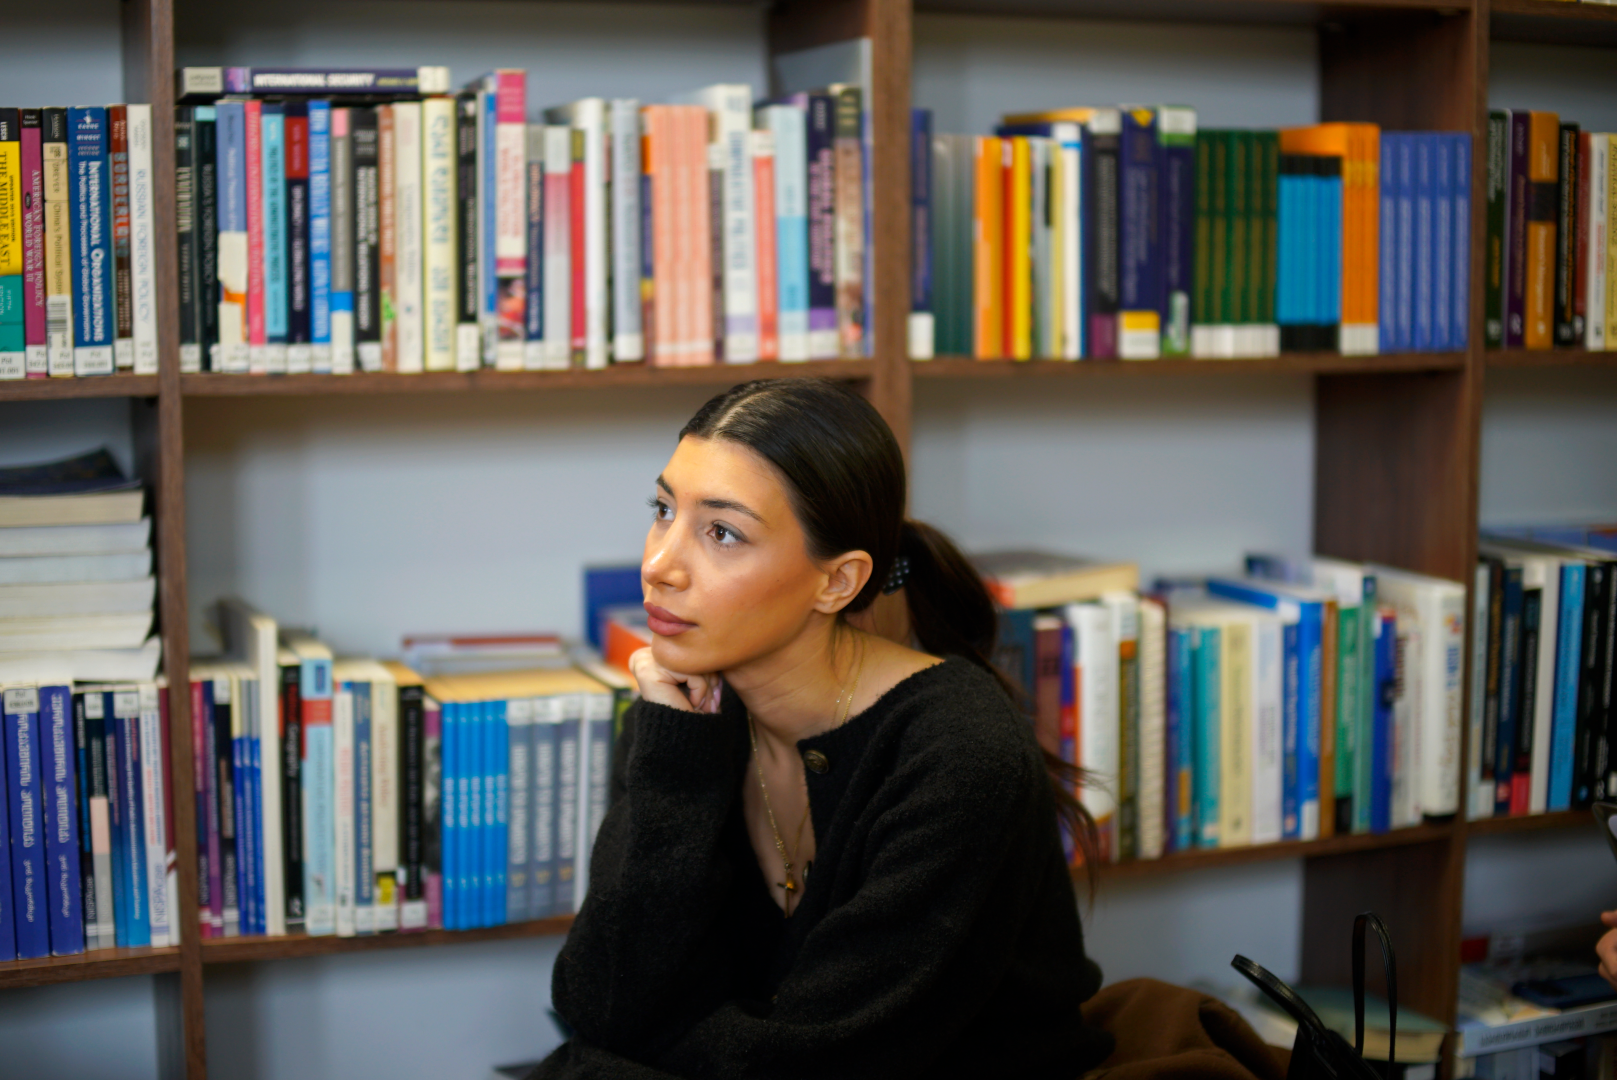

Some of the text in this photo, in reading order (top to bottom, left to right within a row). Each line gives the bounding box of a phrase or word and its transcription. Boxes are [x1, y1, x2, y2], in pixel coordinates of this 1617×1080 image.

[254, 73, 326, 87] INTERNATIONAL
[327, 73, 375, 87] SECURITY
[78, 160, 87, 175] The
[78, 176, 87, 201] Politics
[0, 151, 10, 266] THE MIDDLE EAST
[25, 211, 33, 248] WORLD
[31, 169, 44, 308] AMERICAN FOREIGN POLICY
[26, 250, 34, 271] WAR
[53, 203, 64, 296] China's Political System
[88, 160, 105, 342] INTERNATIONAL ORGANIZATIONS
[135, 168, 150, 324] RUSSIAN FOREIGN POLICY
[17, 713, 32, 786] როკავშირის
